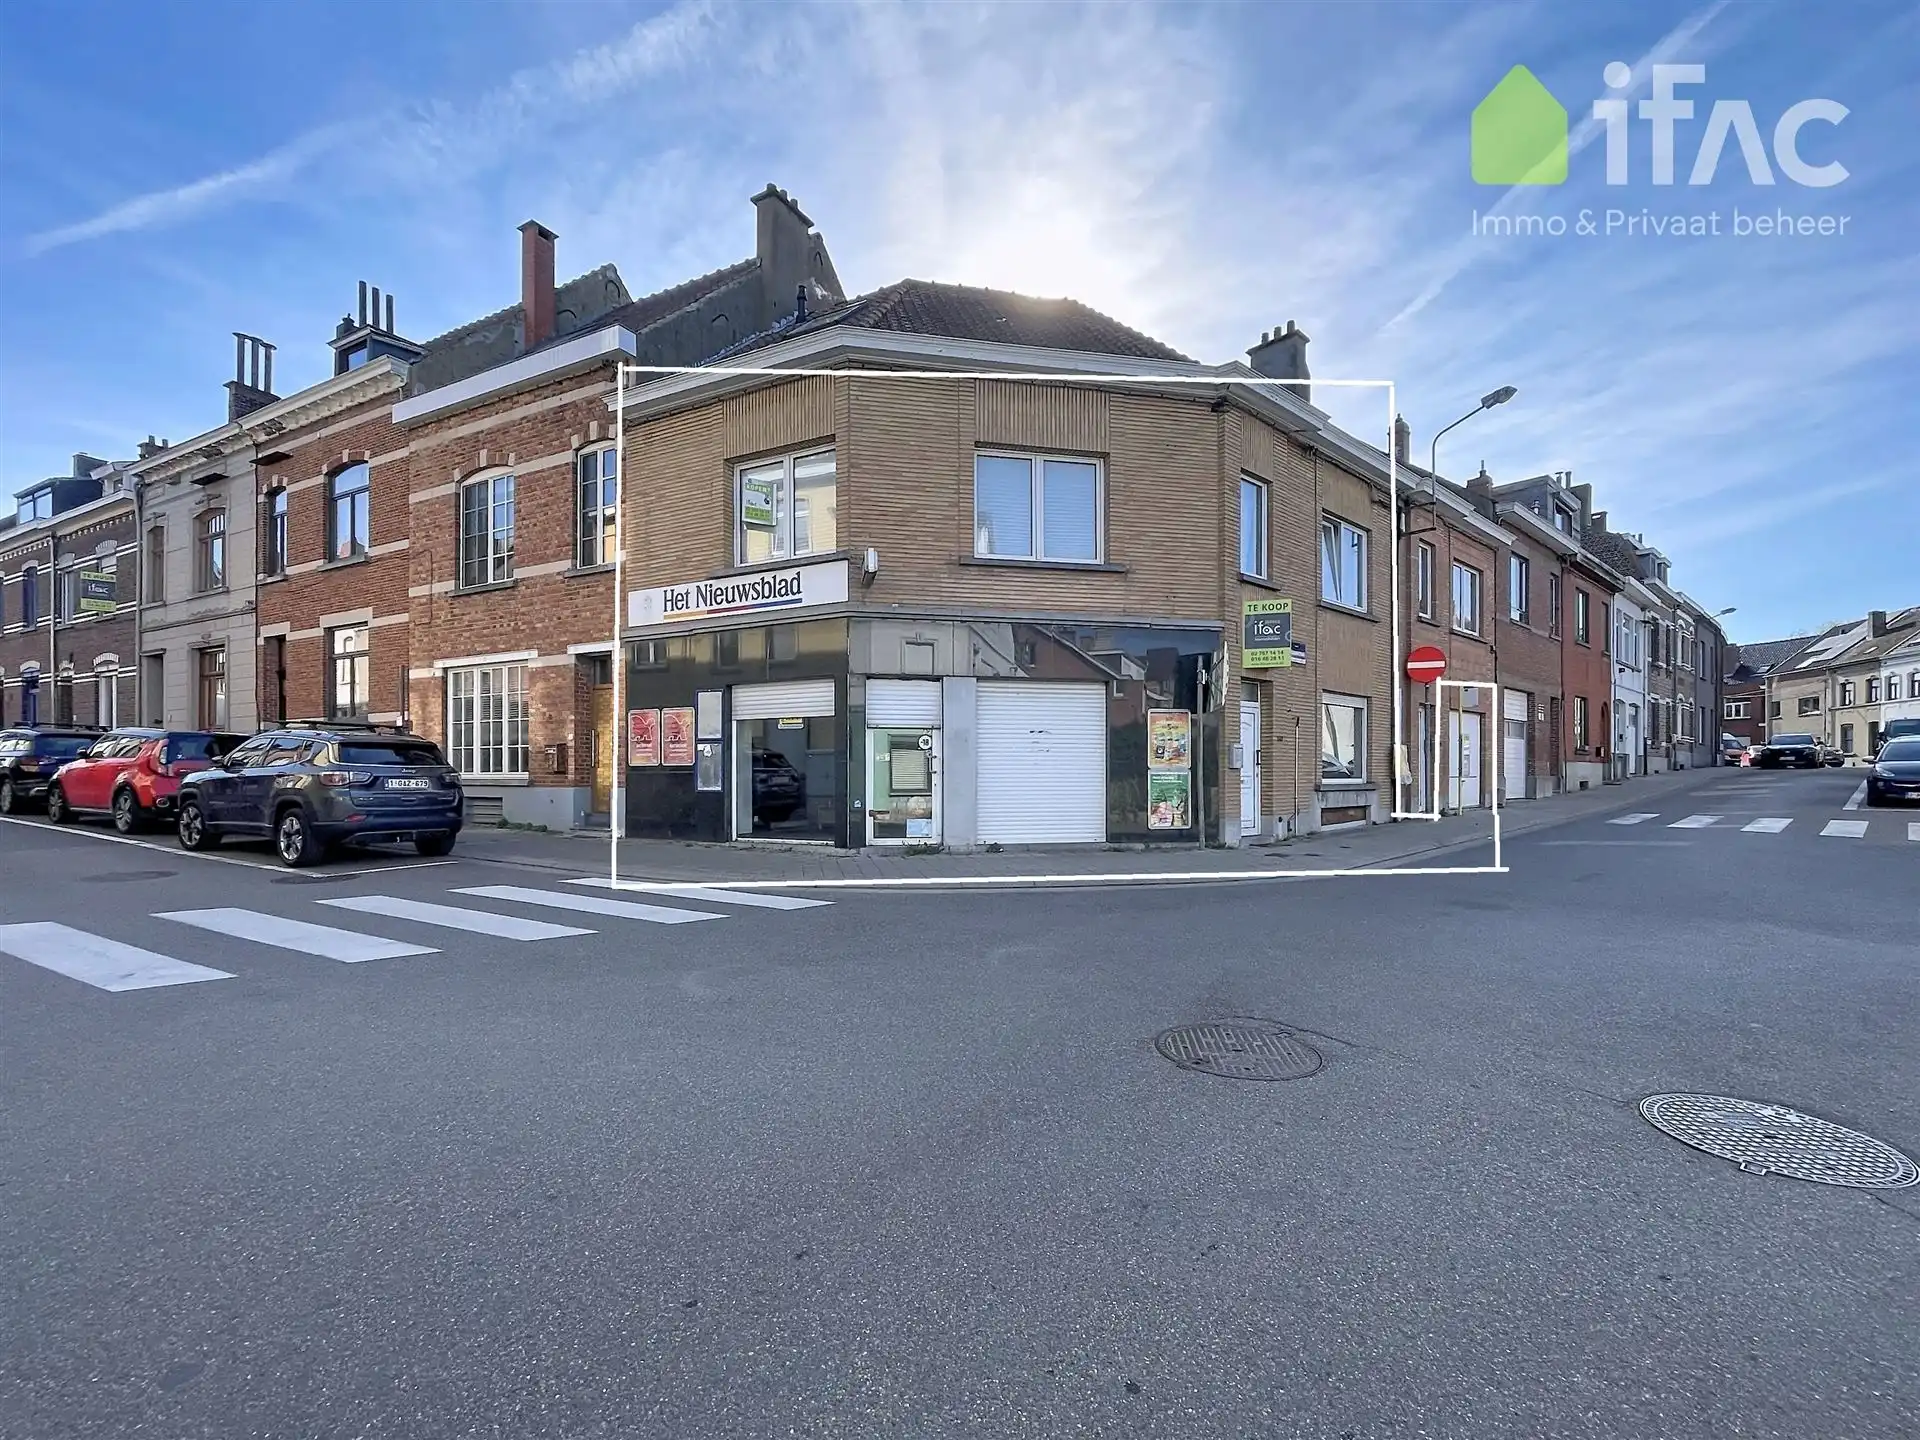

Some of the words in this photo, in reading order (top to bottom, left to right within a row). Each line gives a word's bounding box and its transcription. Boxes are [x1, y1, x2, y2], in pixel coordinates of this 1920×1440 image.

[663, 588, 690, 612] Het
[696, 571, 802, 609] Nieuwsblad
[1248, 604, 1259, 612] TE
[1262, 603, 1289, 611] KOOP
[1254, 620, 1281, 635] ifac
